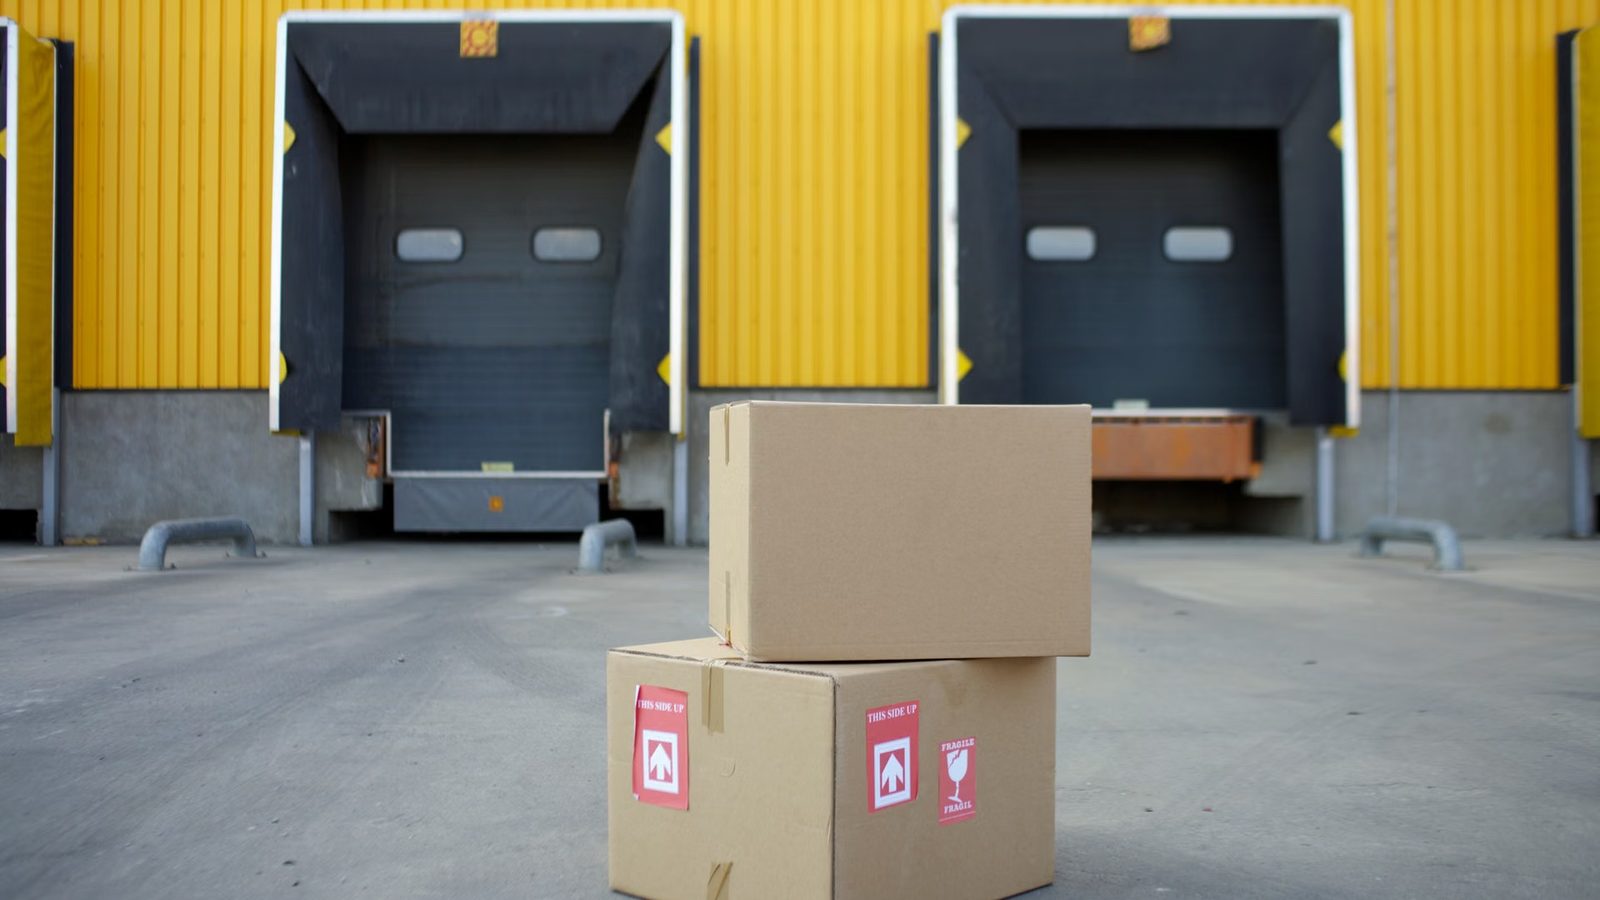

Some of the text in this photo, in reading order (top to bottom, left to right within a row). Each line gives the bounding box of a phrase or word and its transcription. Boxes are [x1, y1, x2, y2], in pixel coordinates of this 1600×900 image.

[655, 701, 672, 712] SIDE
[673, 703, 684, 713] UP
[867, 704, 917, 723] THIS SIDE UP
[941, 738, 975, 752] FRAGILE
[944, 801, 972, 814] FRAGIL
